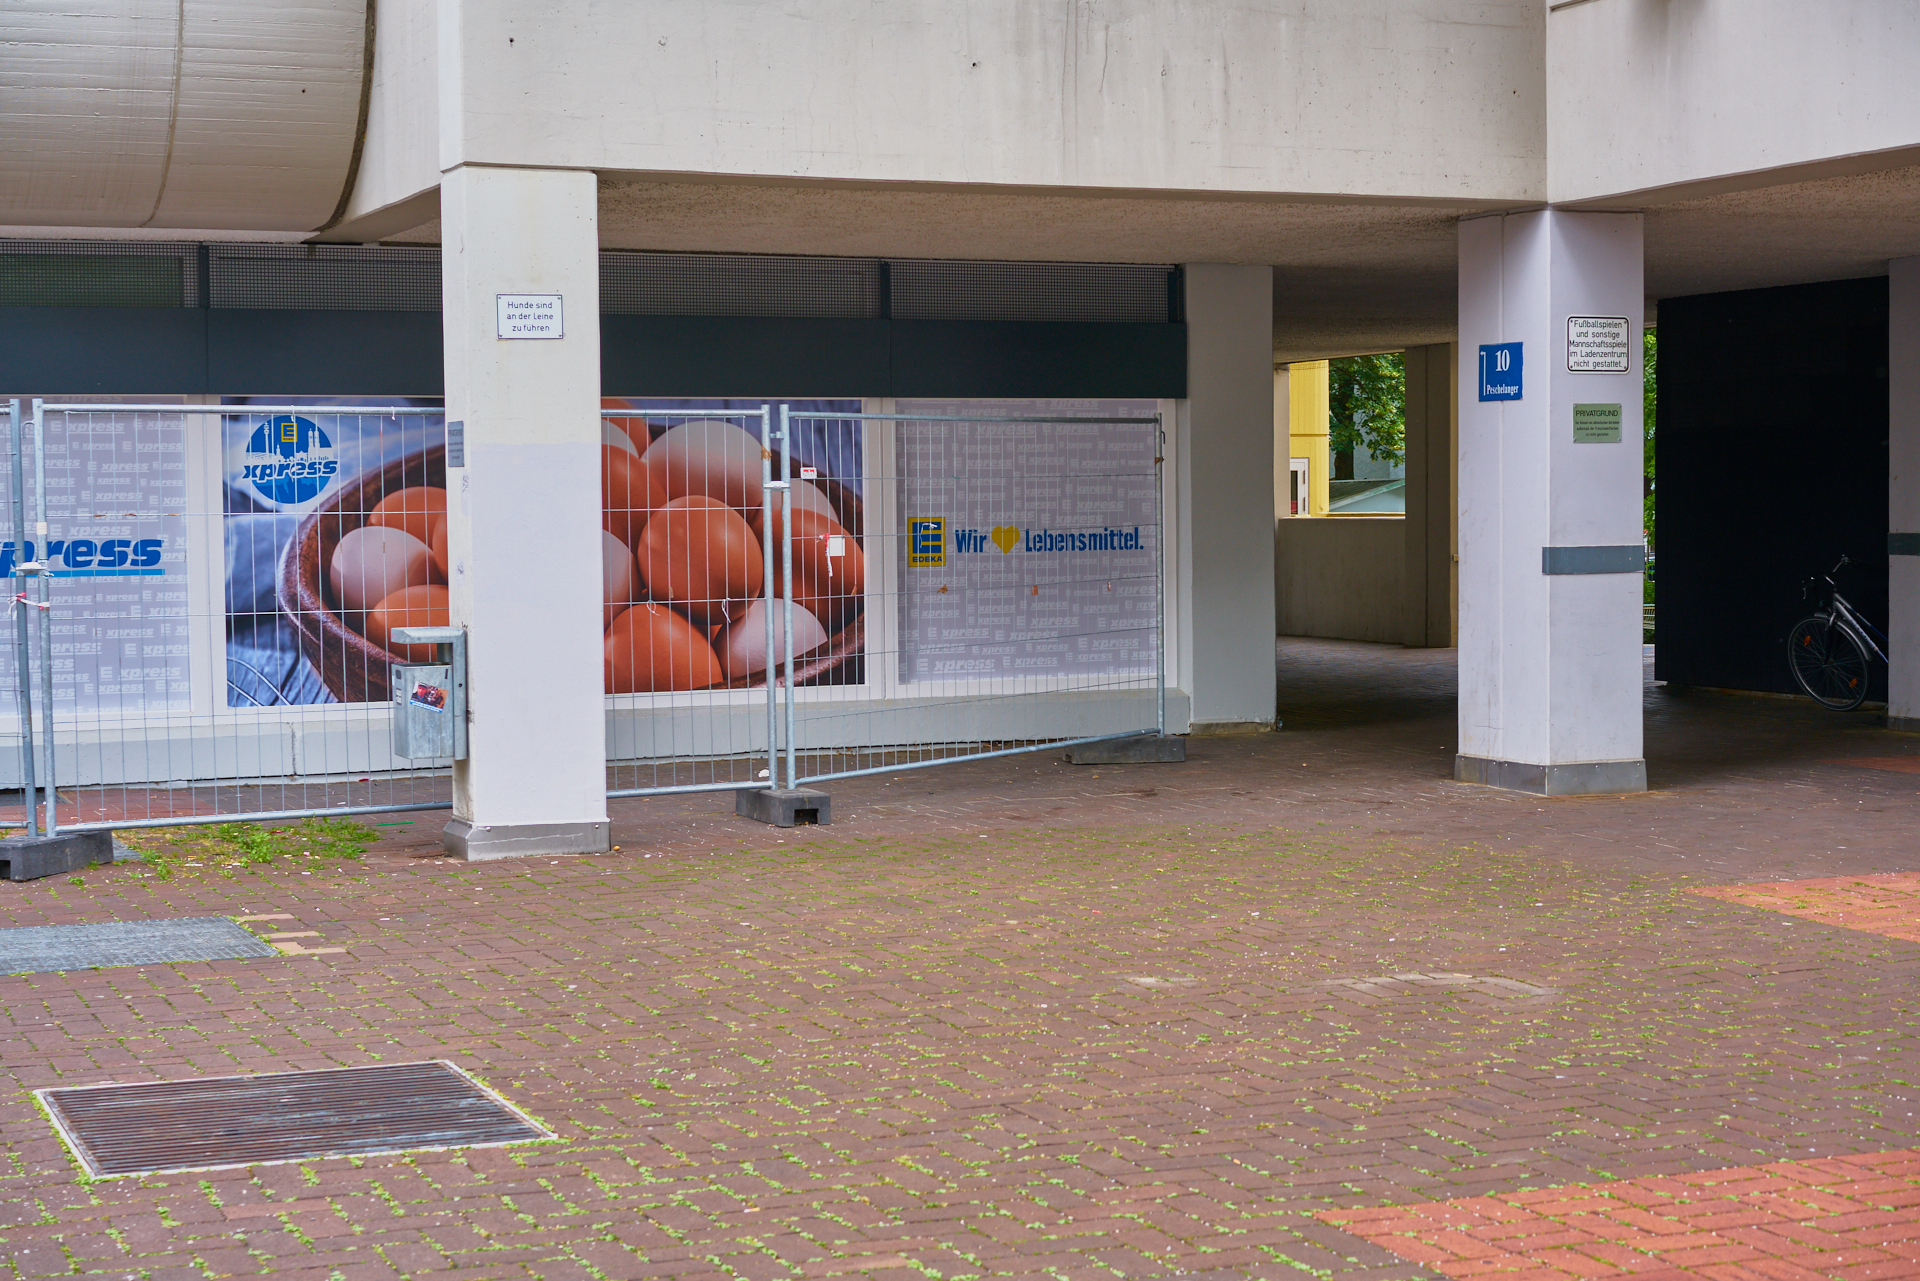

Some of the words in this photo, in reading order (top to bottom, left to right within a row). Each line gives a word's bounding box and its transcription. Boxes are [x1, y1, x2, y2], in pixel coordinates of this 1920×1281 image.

[507, 301, 534, 309] Hunde
[536, 301, 553, 309] sind
[518, 312, 531, 320] der
[533, 312, 554, 320] Leine
[523, 324, 550, 332] führen
[1573, 320, 1622, 330] Fußballspielen
[1576, 330, 1589, 338] und
[1591, 331, 1620, 340] sonstige
[1569, 340, 1627, 350] Mannschaftsspiele
[1570, 350, 1578, 358] im
[1580, 350, 1628, 358] Ladenzentrum
[1495, 349, 1511, 372] 10
[1573, 359, 1590, 368] nicht
[1592, 360, 1623, 370] gestattet.
[1486, 384, 1519, 396] Peschelanger
[242, 460, 338, 482] xpress
[955, 529, 987, 553] Wir
[1026, 527, 1144, 552] Lebensmittel.
[932, 659, 996, 674] xpress
